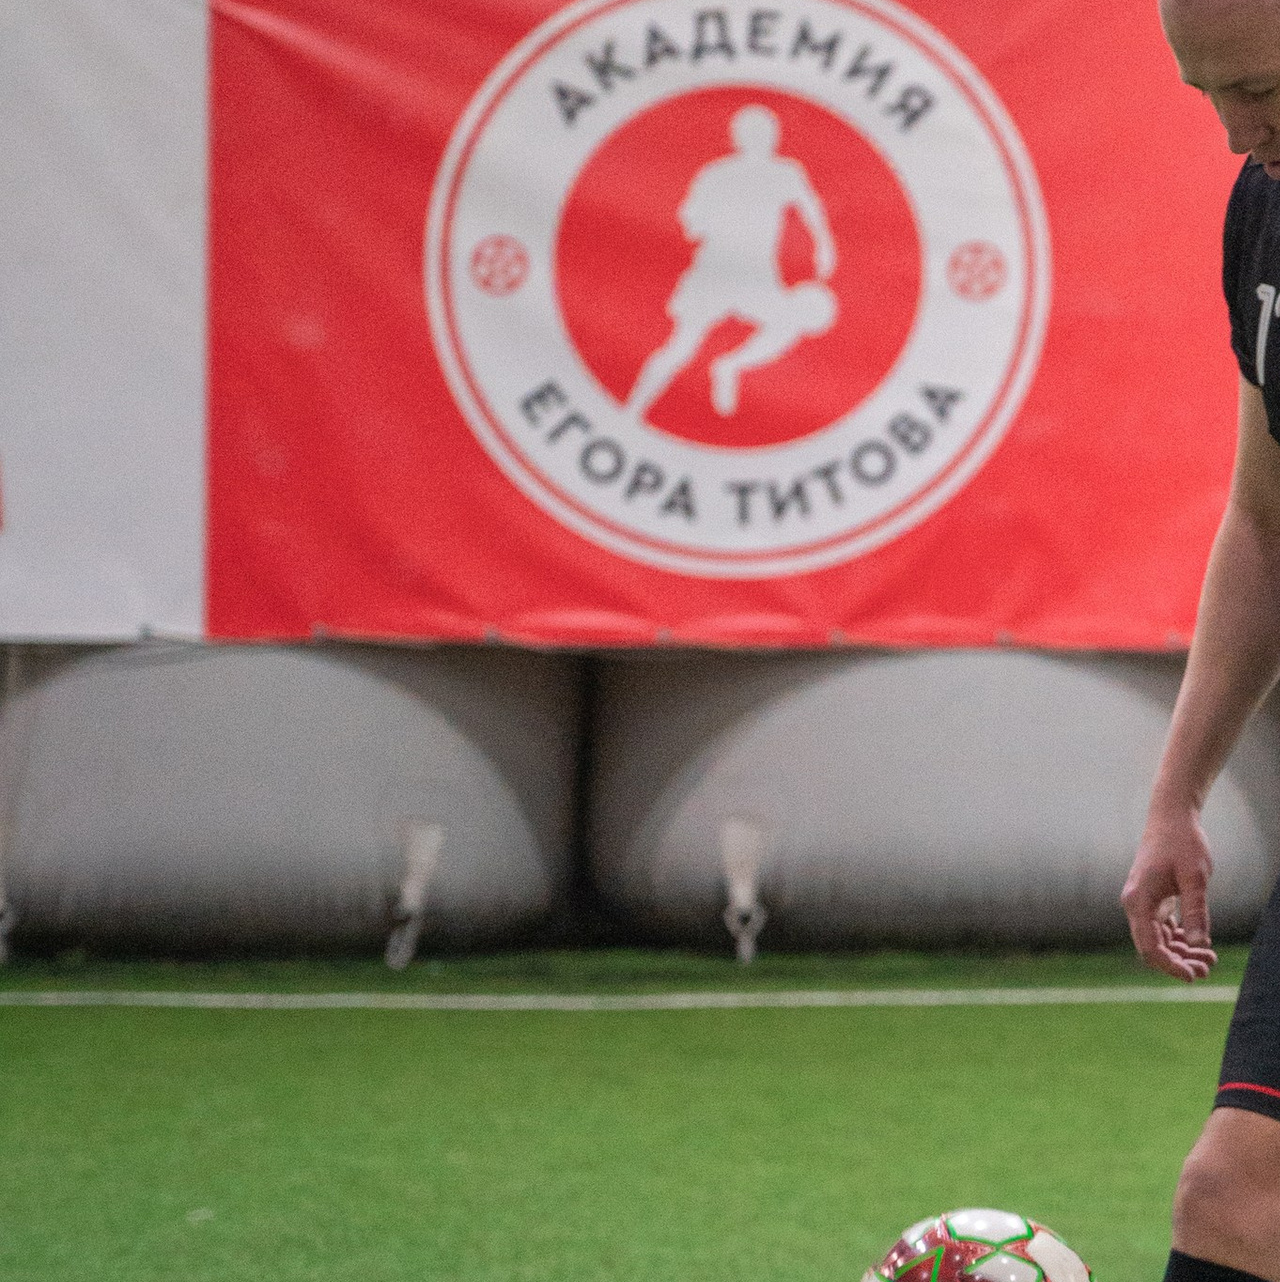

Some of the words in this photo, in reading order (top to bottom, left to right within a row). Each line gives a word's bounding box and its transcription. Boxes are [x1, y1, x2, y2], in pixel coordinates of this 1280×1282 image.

[549, 7, 938, 134] АКАДЕМИЯ
[518, 379, 697, 522] ЕГОРА
[724, 382, 964, 529] ТИТОВА
